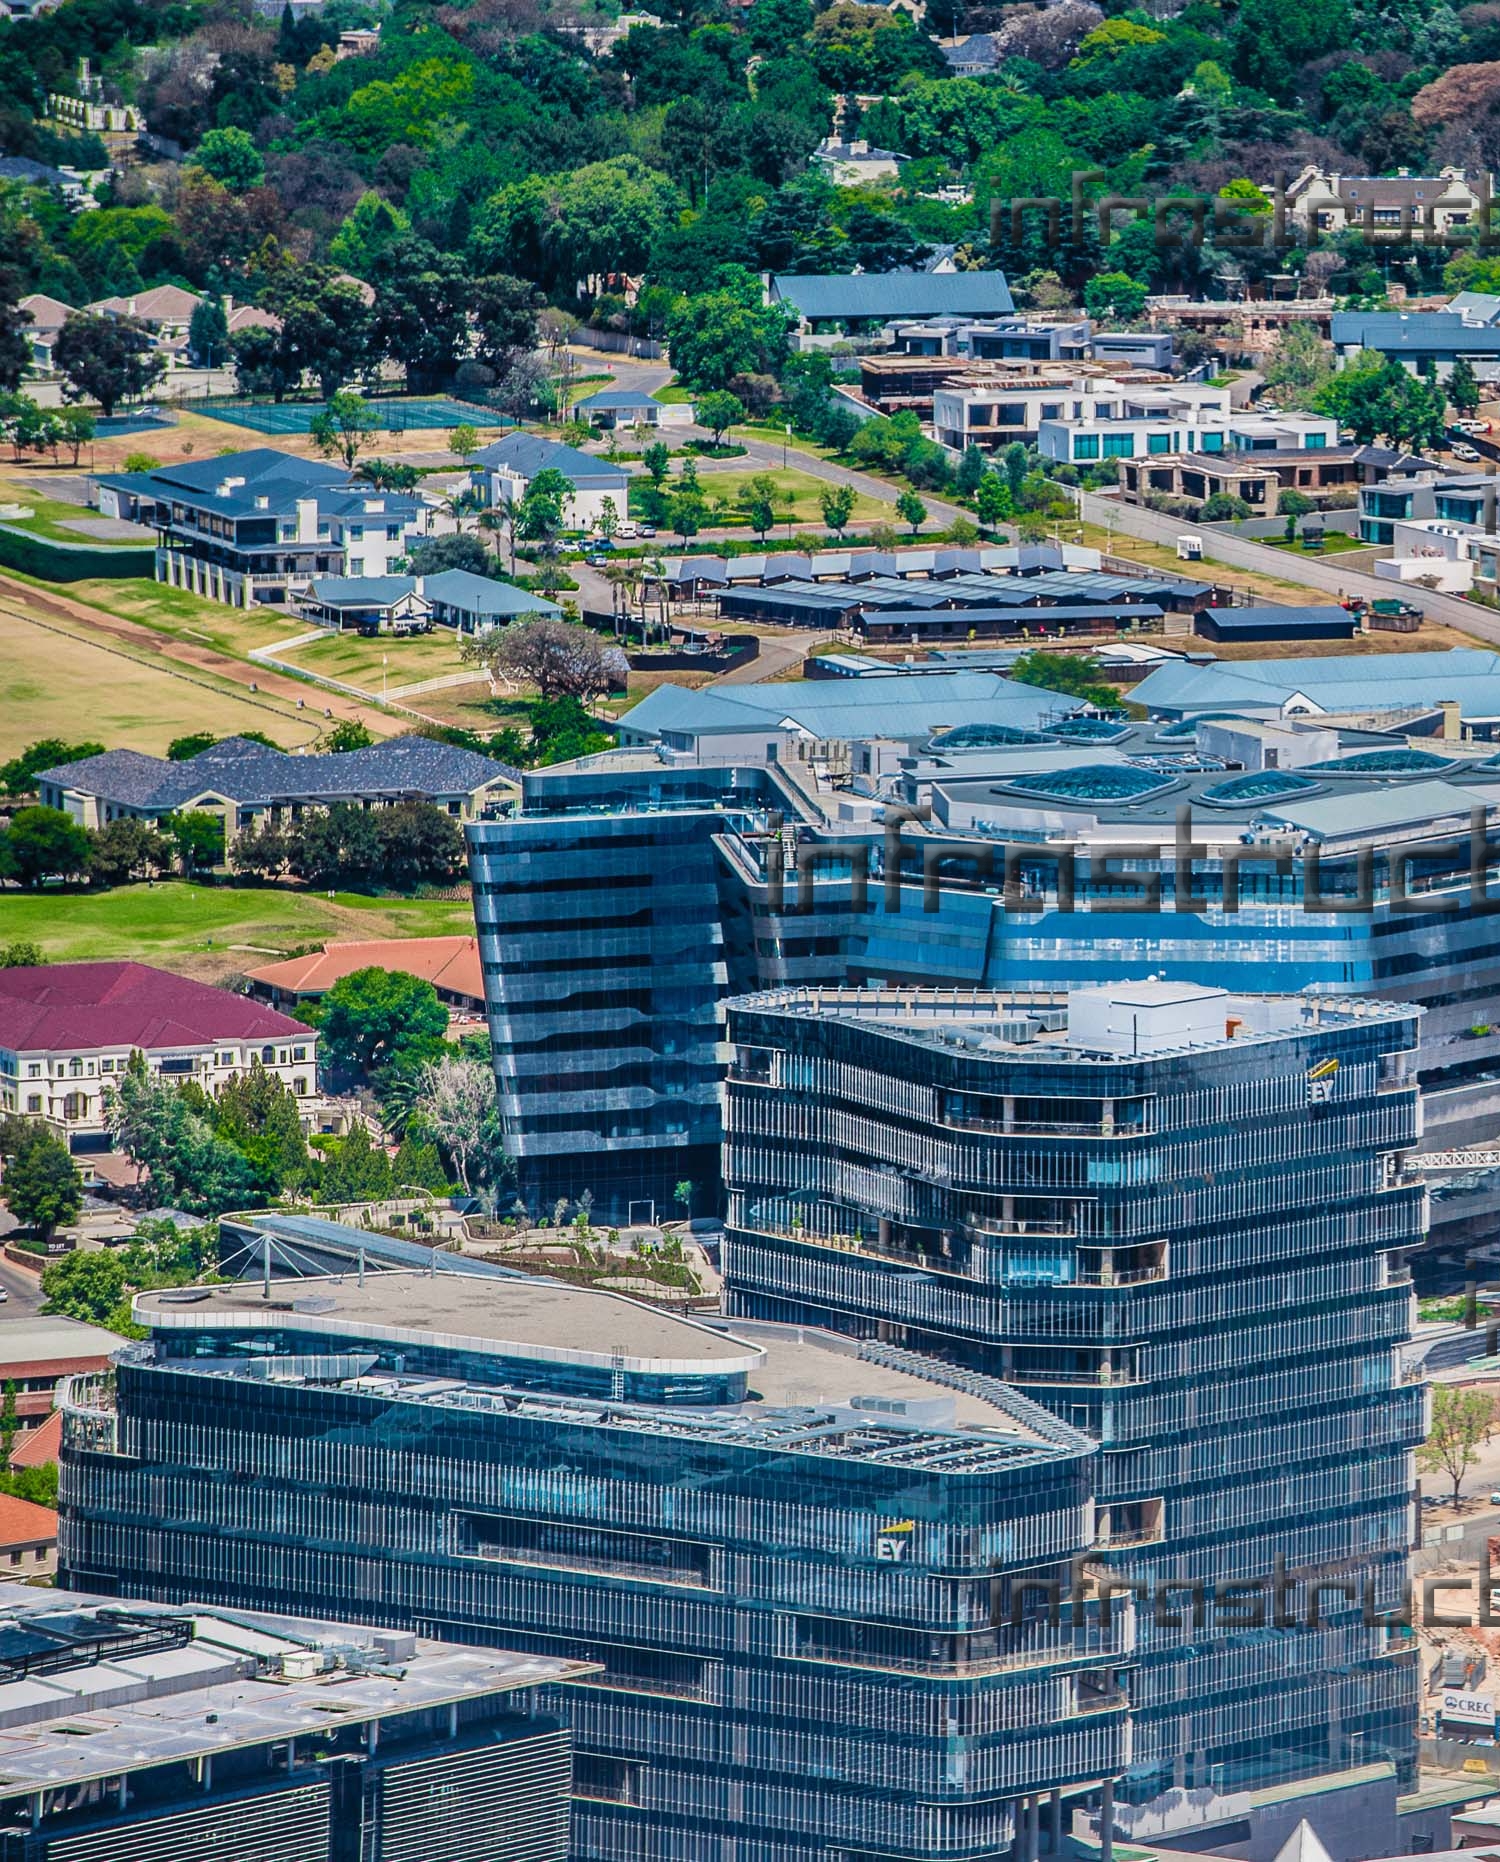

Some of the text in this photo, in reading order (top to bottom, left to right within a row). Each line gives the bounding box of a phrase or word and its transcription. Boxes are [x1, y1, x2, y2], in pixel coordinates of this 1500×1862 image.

[1311, 1079, 1334, 1104] EY
[877, 1538, 906, 1561] EY
[1458, 1699, 1493, 1714] CREC
